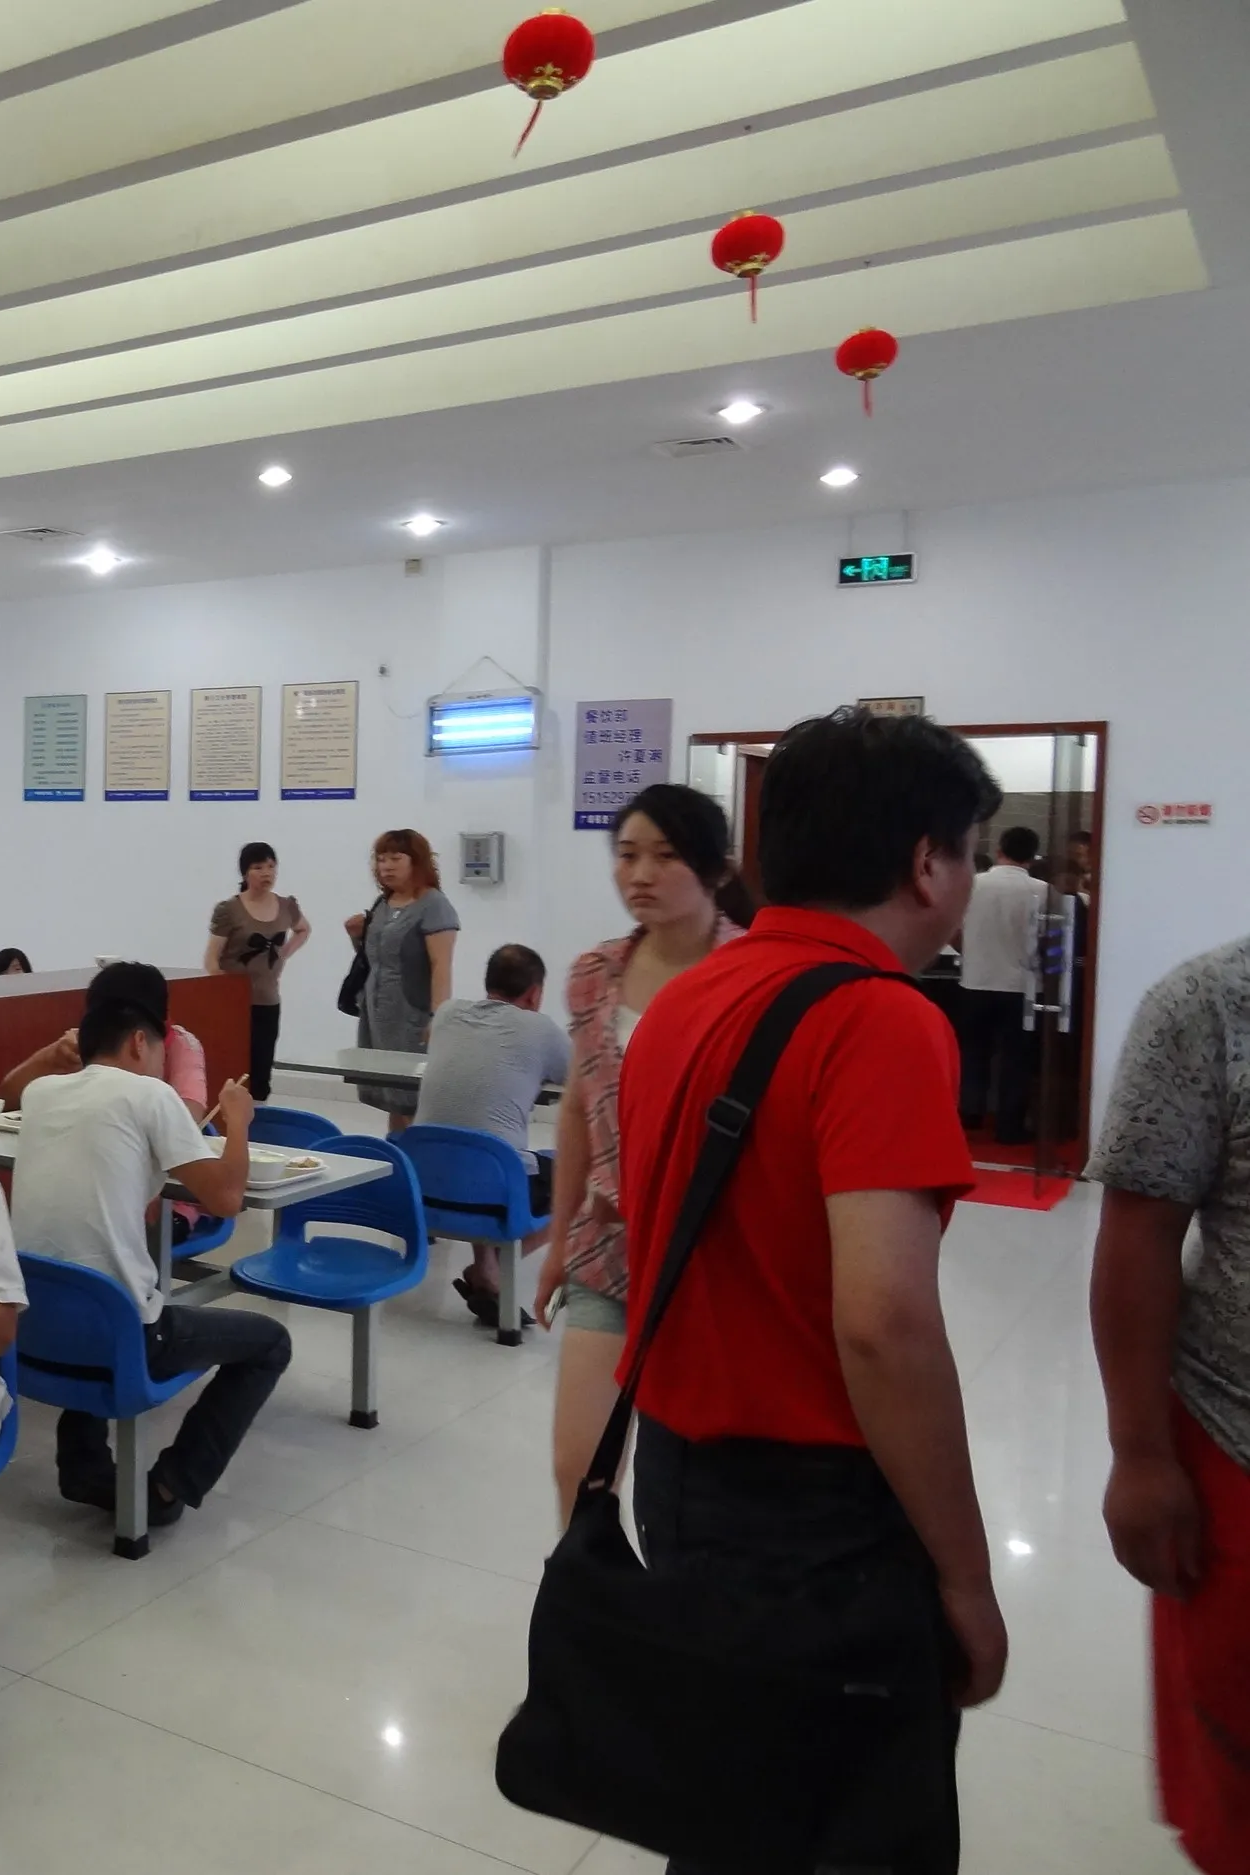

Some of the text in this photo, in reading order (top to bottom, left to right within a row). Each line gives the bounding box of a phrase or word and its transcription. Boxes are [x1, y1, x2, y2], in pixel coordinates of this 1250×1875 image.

[585, 709, 628, 723] 餐饮部
[584, 728, 642, 743] 值班经理
[582, 769, 642, 784] 监督电话
